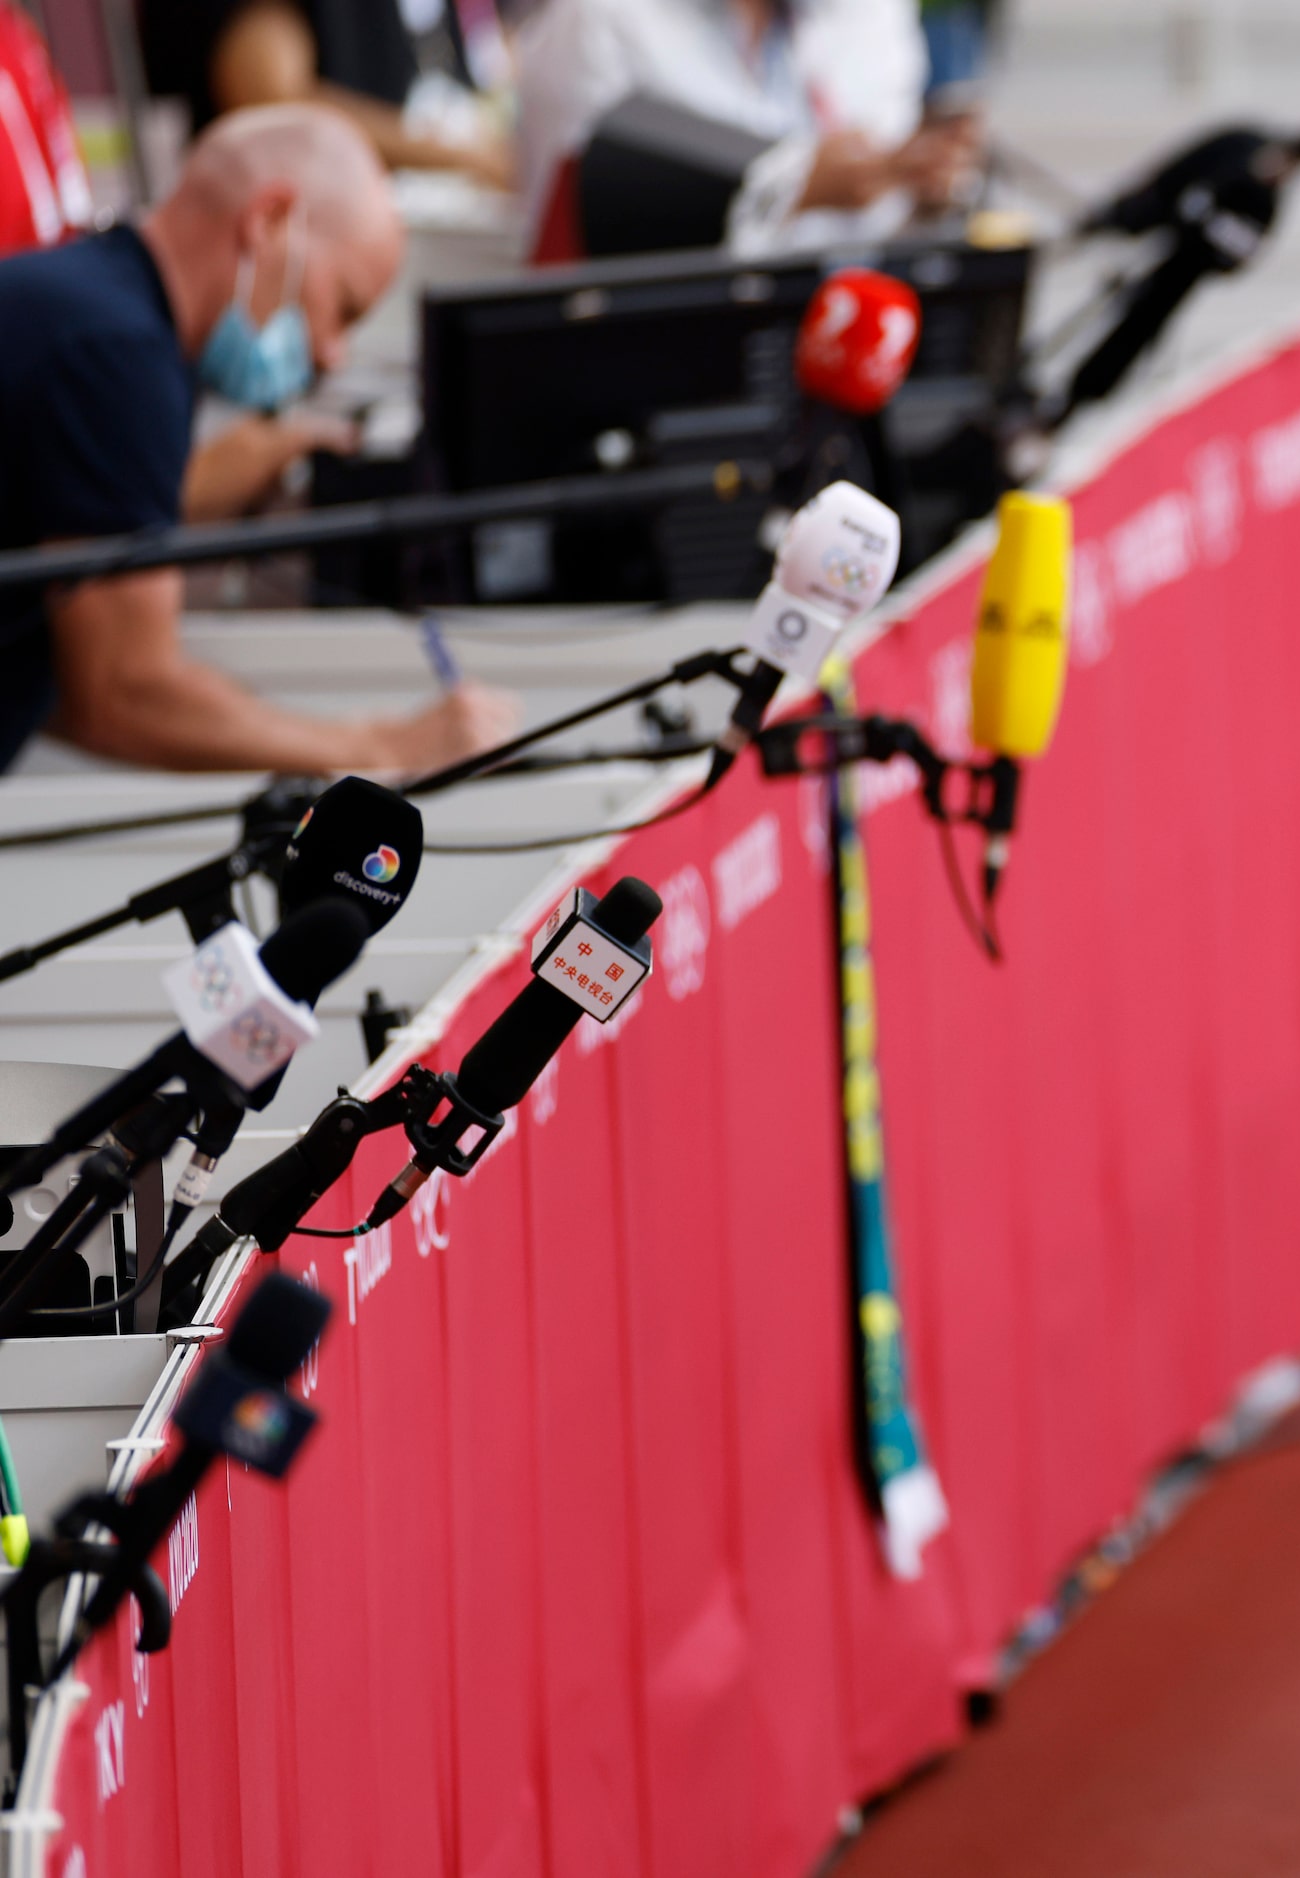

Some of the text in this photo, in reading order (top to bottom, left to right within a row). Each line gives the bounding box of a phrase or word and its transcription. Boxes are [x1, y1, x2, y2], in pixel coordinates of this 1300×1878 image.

[333, 871, 401, 905] discovery+
[554, 956, 613, 1005] 中央电视台
